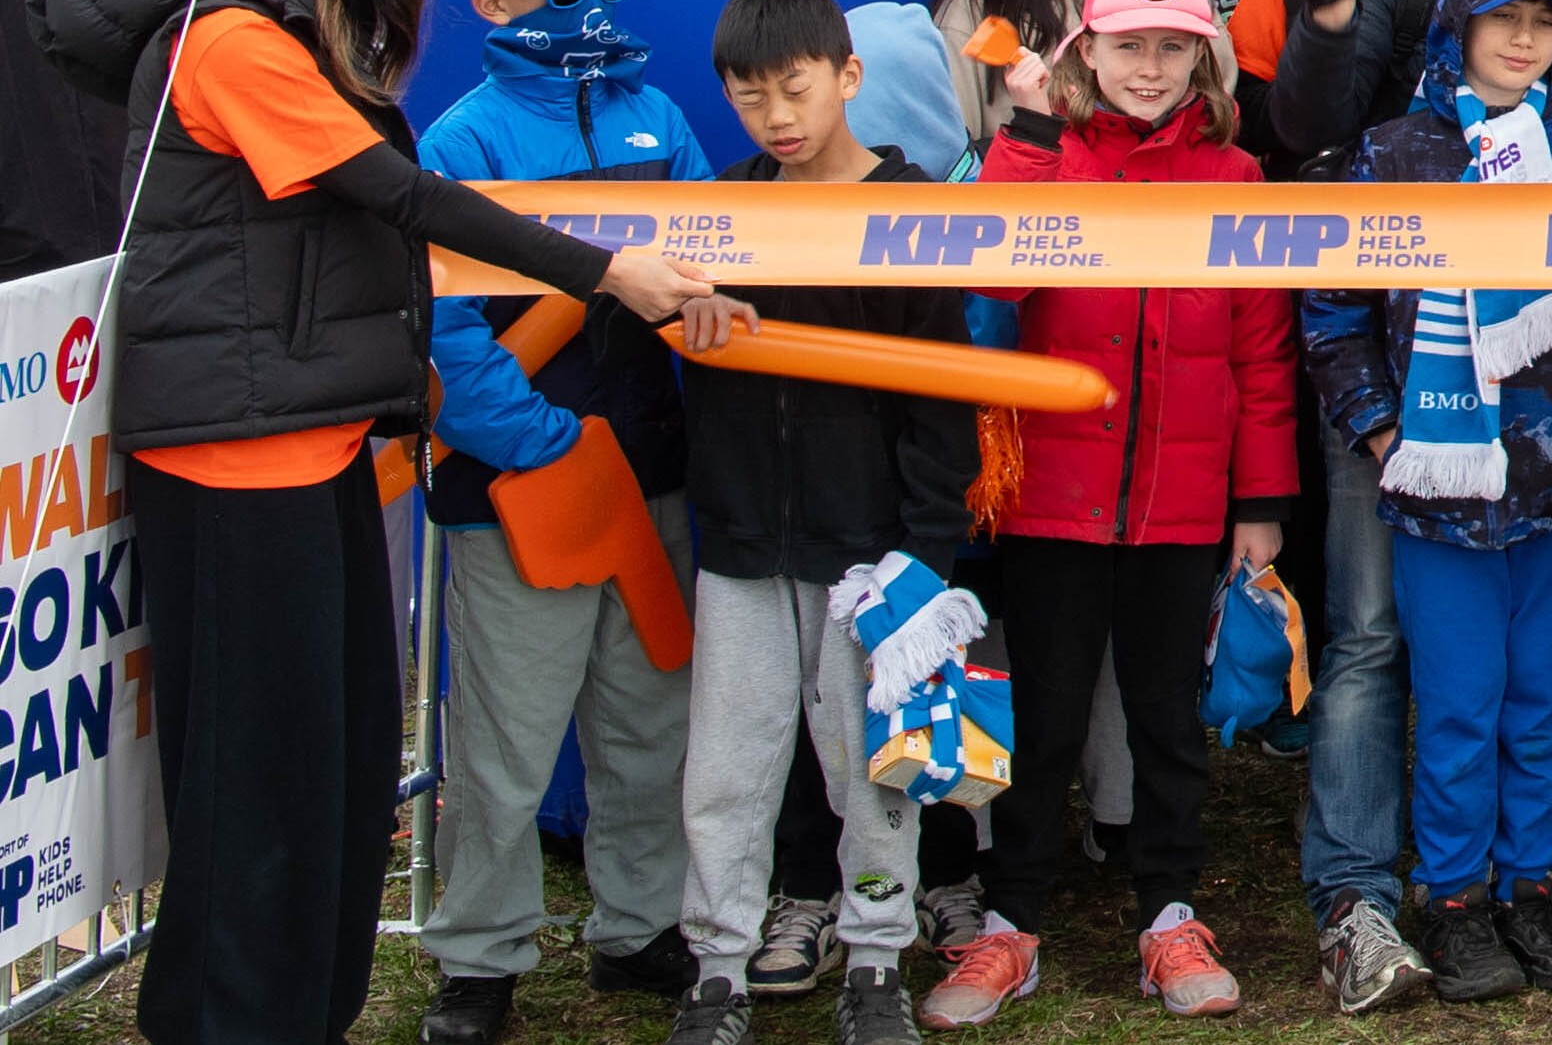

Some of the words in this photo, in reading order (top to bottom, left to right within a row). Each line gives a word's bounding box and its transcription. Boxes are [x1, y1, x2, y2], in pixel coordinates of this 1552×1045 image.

[669, 215, 732, 231] KIDS
[664, 235, 735, 249] HELP
[859, 215, 1006, 266] KHP
[1016, 216, 1080, 231] KIDS
[1014, 235, 1084, 250] HELP
[1207, 215, 1349, 267] KHP
[1360, 215, 1423, 230] KIDS
[1359, 235, 1426, 250] HELP
[1011, 253, 1104, 267] PHONE
[1357, 253, 1447, 268] PHONE
[1418, 389, 1480, 411] BMO
[38, 836, 72, 868] KIDS
[37, 857, 73, 891] HELP
